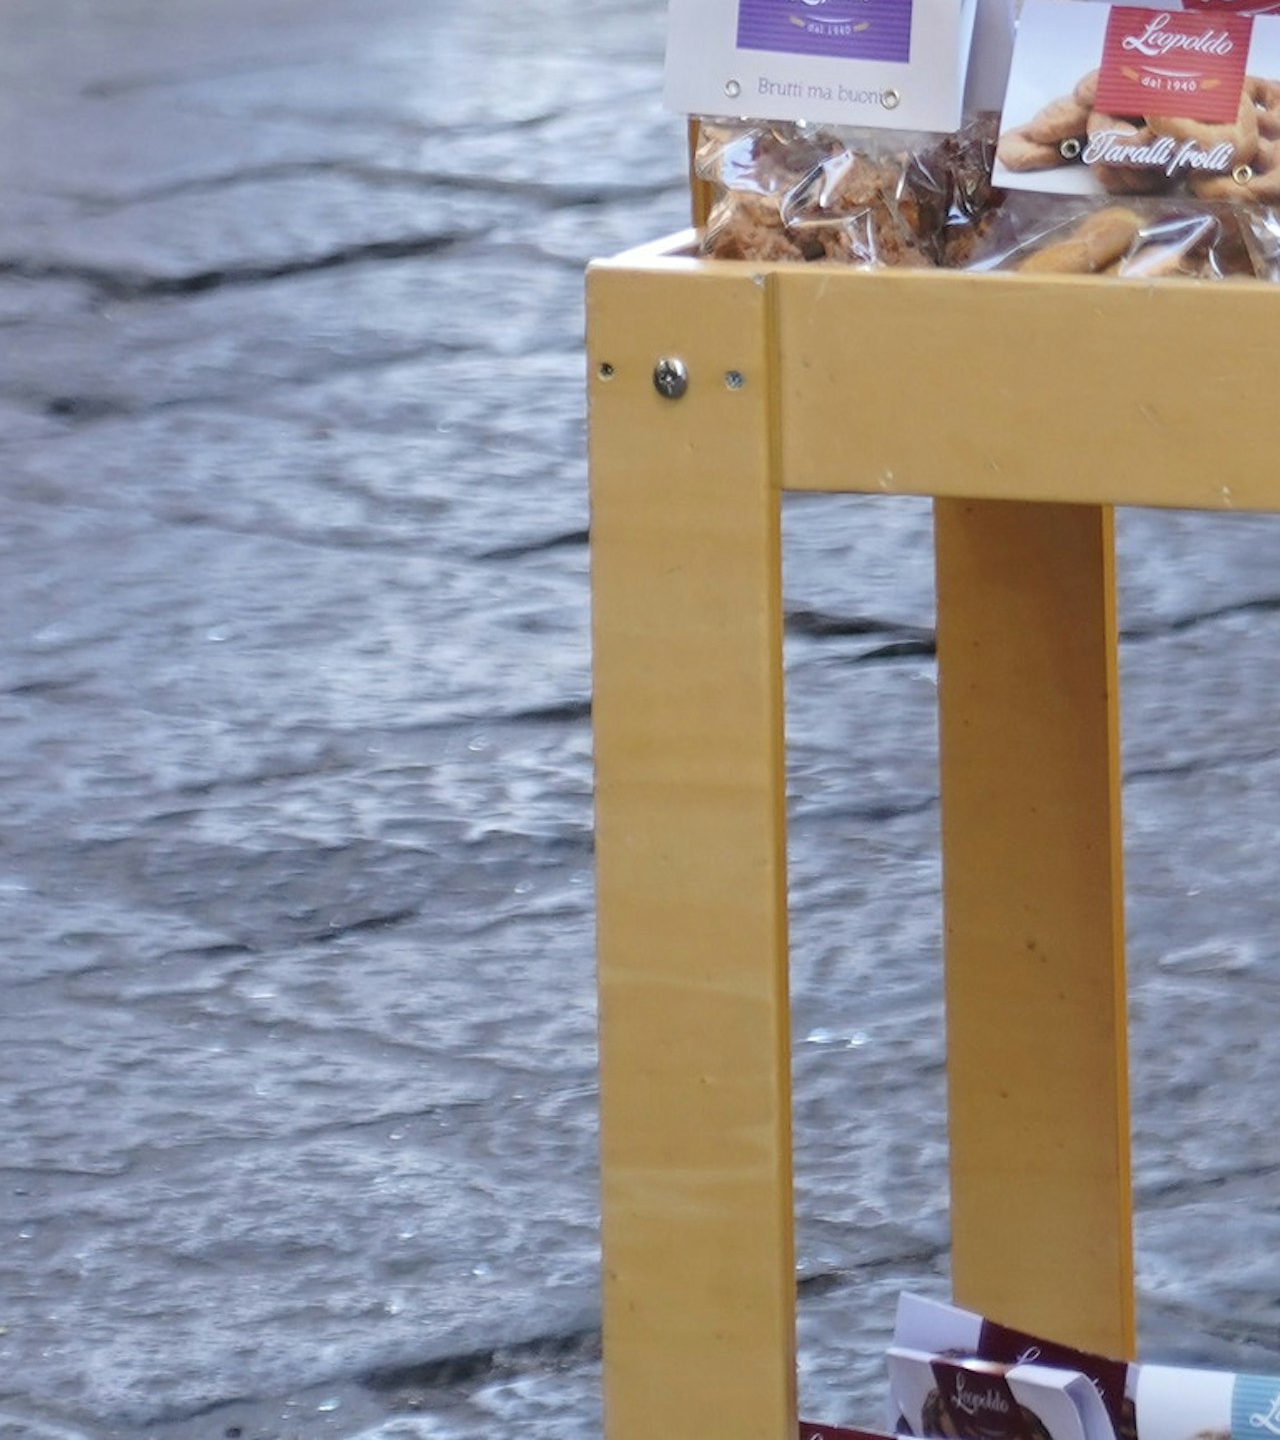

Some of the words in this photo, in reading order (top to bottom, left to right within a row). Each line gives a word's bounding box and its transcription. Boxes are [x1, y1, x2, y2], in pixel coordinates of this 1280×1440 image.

[1122, 13, 1233, 56] Leopoldo
[758, 77, 802, 98] Brutti
[808, 85, 832, 99] ma
[1141, 76, 1160, 89] dal
[1166, 80, 1197, 92] 1940
[1082, 129, 1172, 165] Taralli
[1166, 138, 1235, 178] frolli
